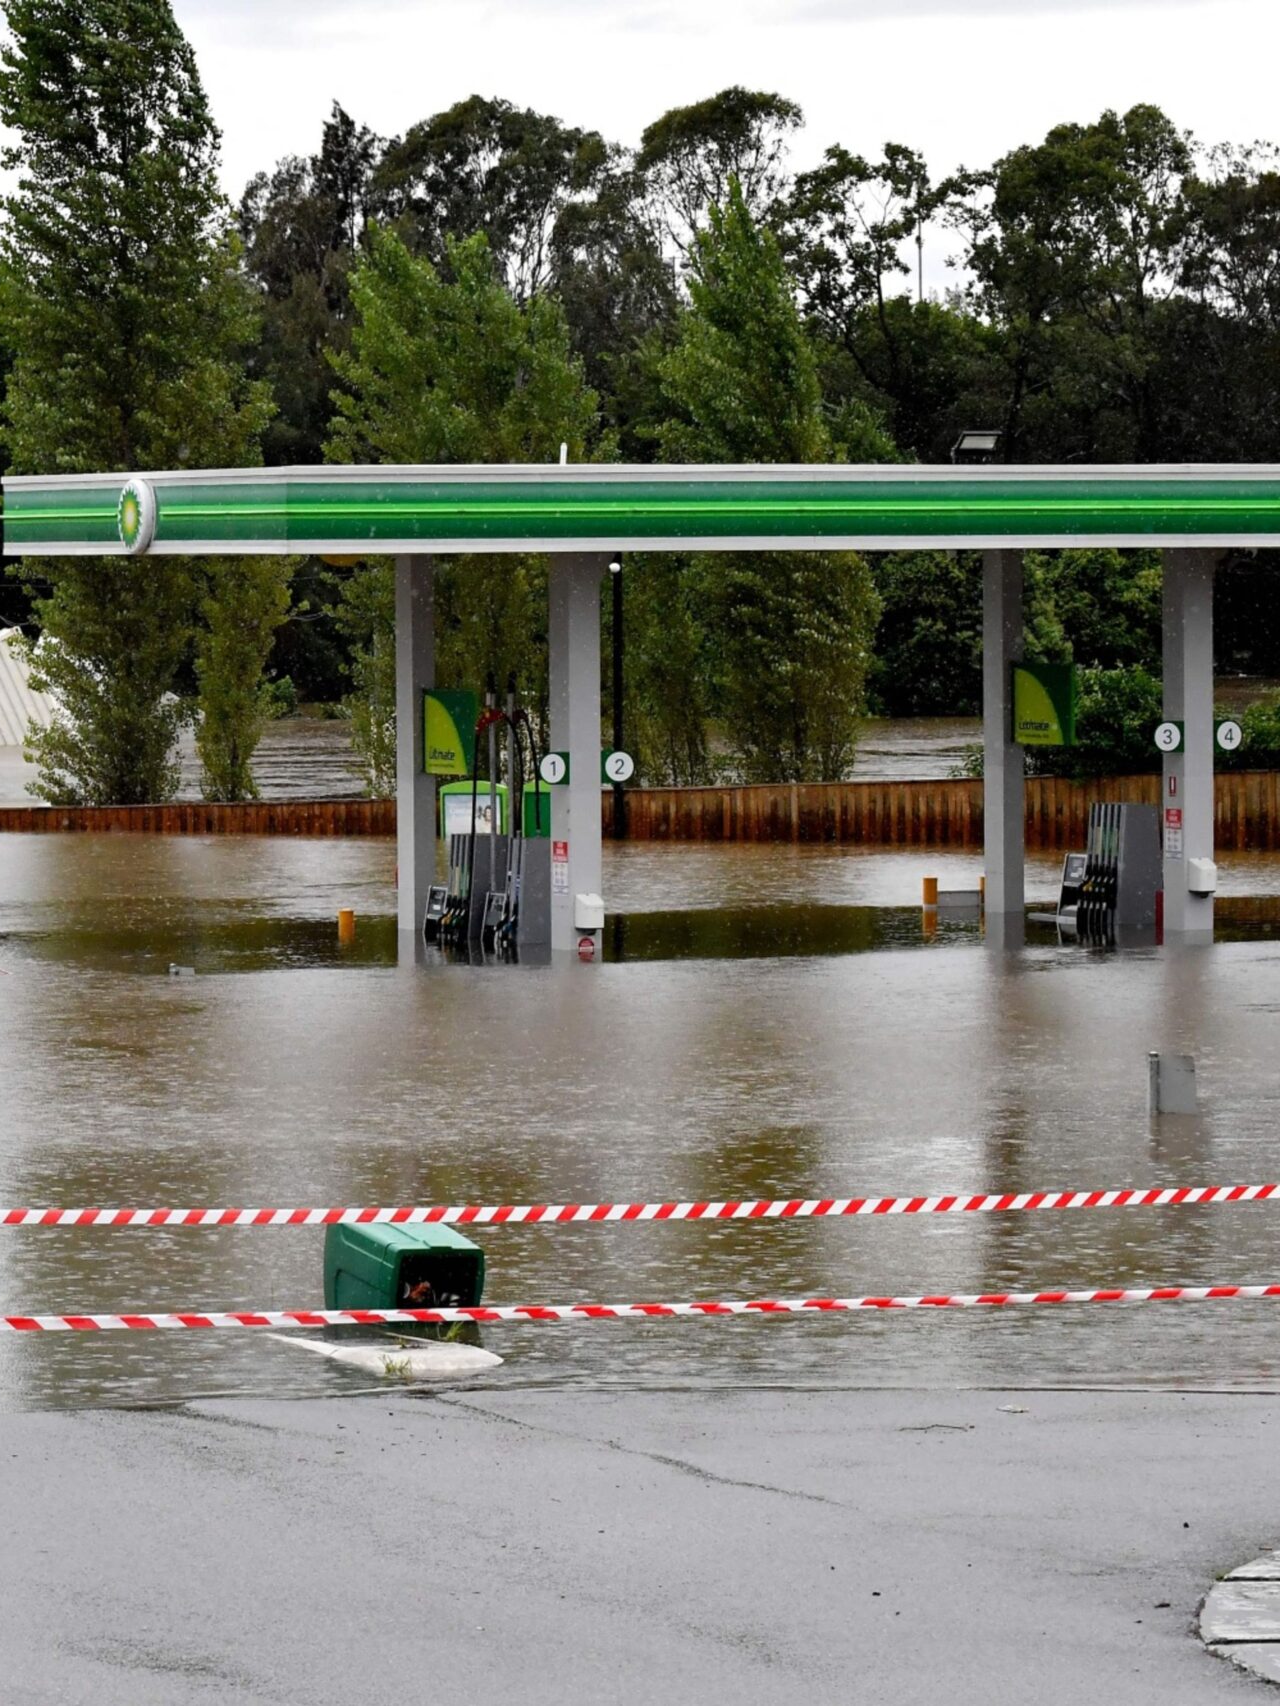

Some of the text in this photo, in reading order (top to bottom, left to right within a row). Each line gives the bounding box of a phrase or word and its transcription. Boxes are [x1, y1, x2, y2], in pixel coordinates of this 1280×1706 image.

[1162, 729, 1173, 745] 3
[1224, 728, 1234, 743] 4
[550, 761, 557, 776] 1
[614, 758, 625, 775] 2
